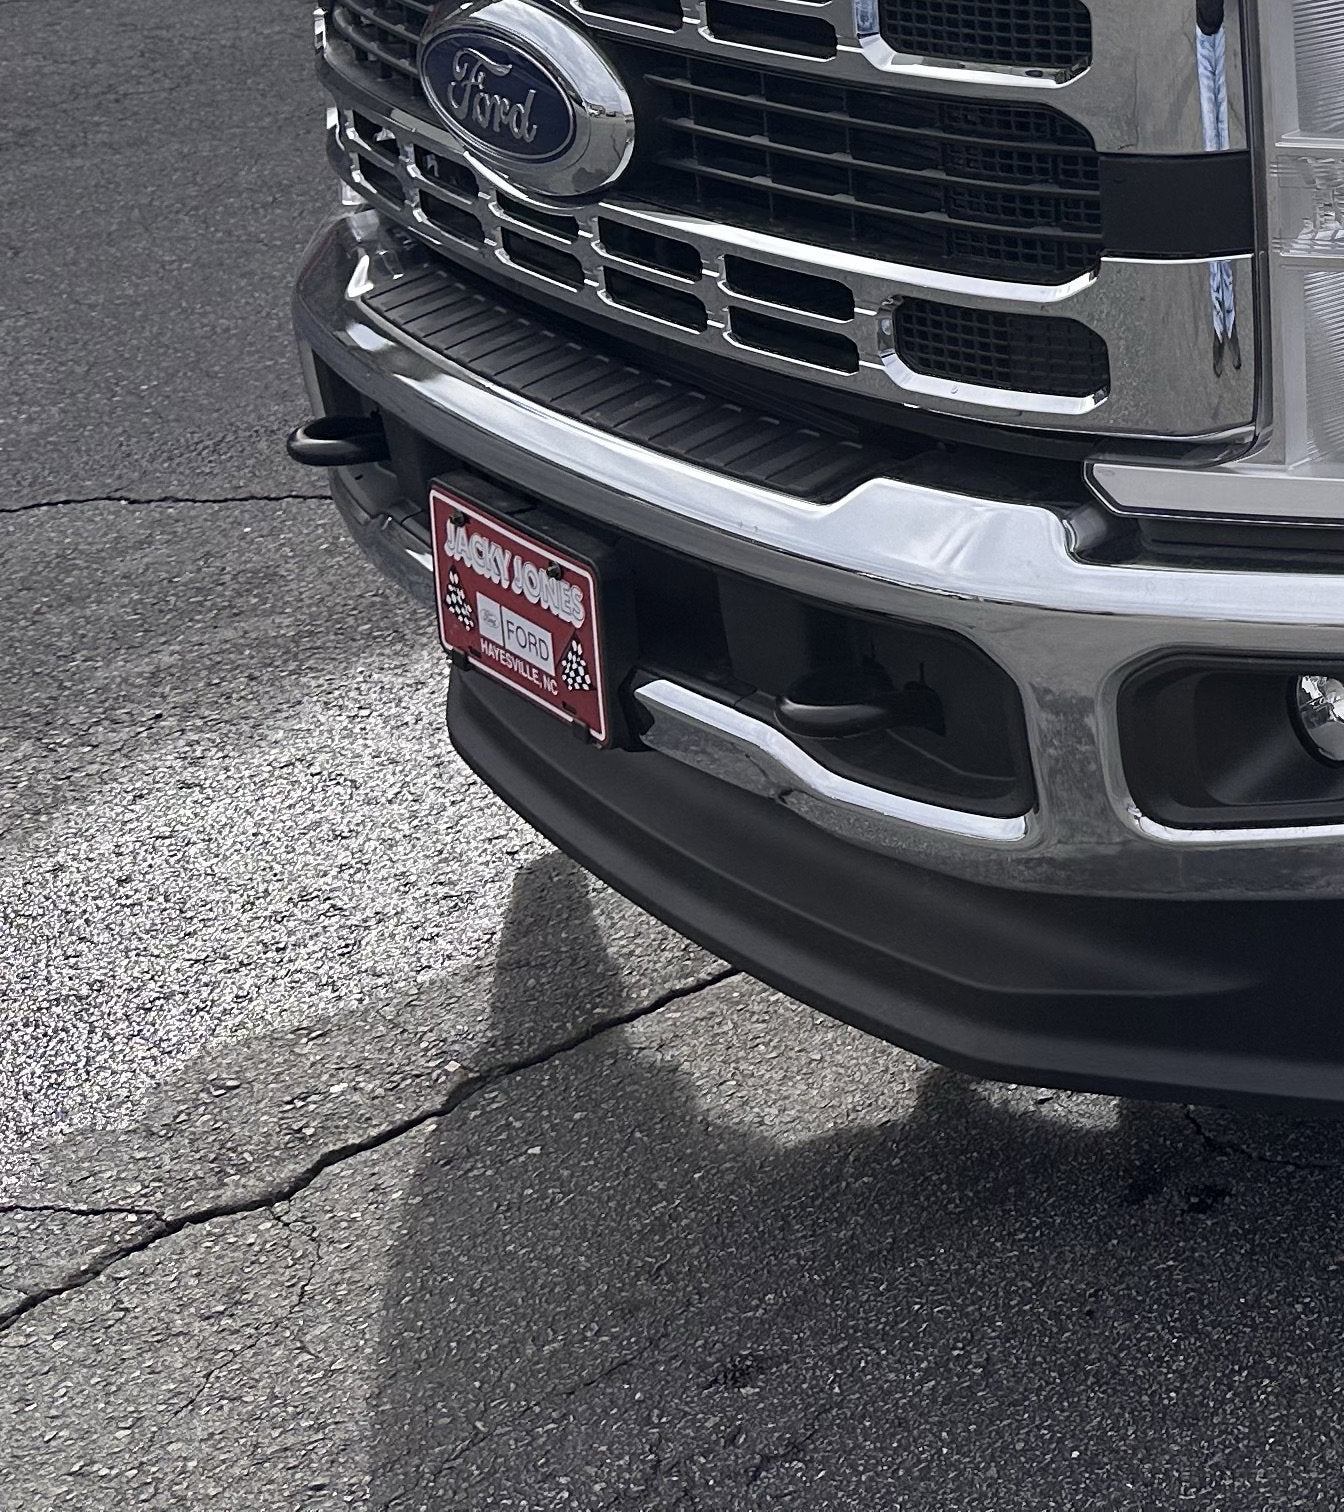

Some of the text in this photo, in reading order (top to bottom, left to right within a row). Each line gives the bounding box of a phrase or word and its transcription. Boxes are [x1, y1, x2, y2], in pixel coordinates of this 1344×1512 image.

[448, 47, 538, 143] Ford
[444, 518, 586, 629] JACKY JONES
[506, 620, 549, 661] FORD
[543, 675, 559, 695] NC
